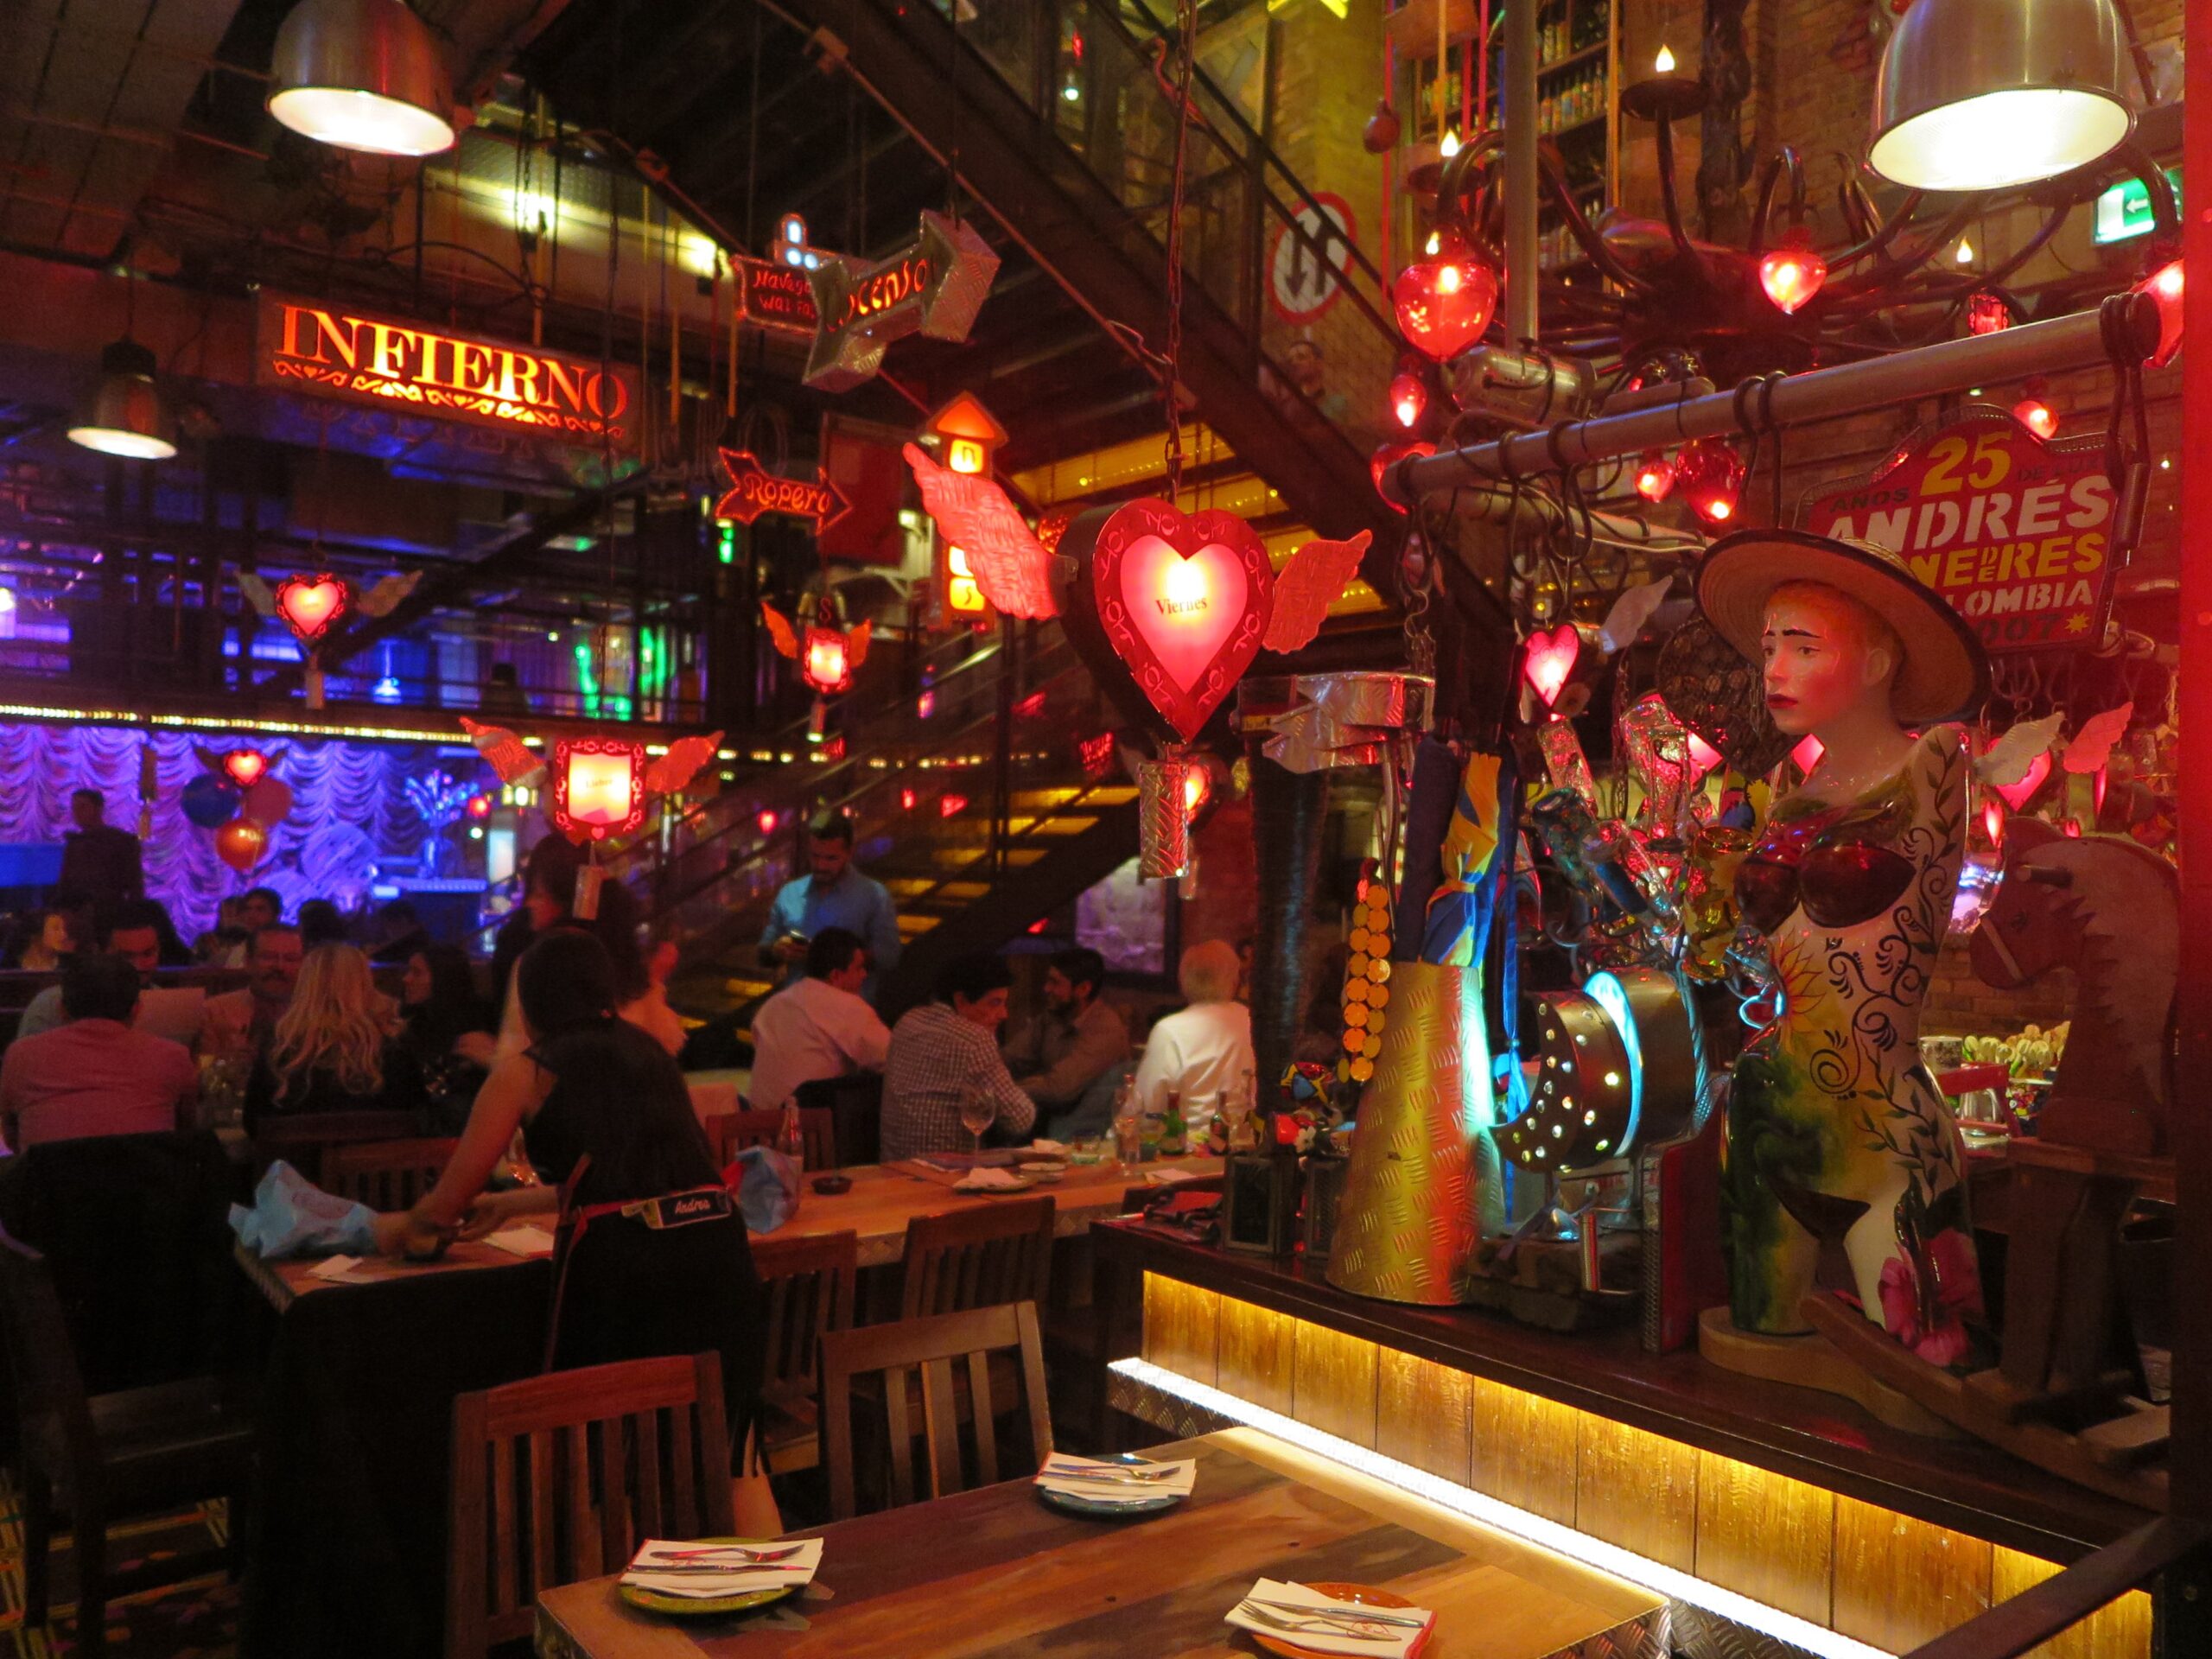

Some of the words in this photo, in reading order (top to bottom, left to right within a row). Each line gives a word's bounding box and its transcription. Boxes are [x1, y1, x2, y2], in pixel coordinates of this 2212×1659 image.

[275, 303, 628, 420] INFIERNO
[1918, 429, 2014, 497] 25
[743, 473, 831, 513] Ropero
[1825, 474, 2112, 552] ANDRÉS
[1995, 532, 2107, 582] RES
[1154, 596, 1208, 615] Viernes
[1975, 613, 2062, 644] 007
